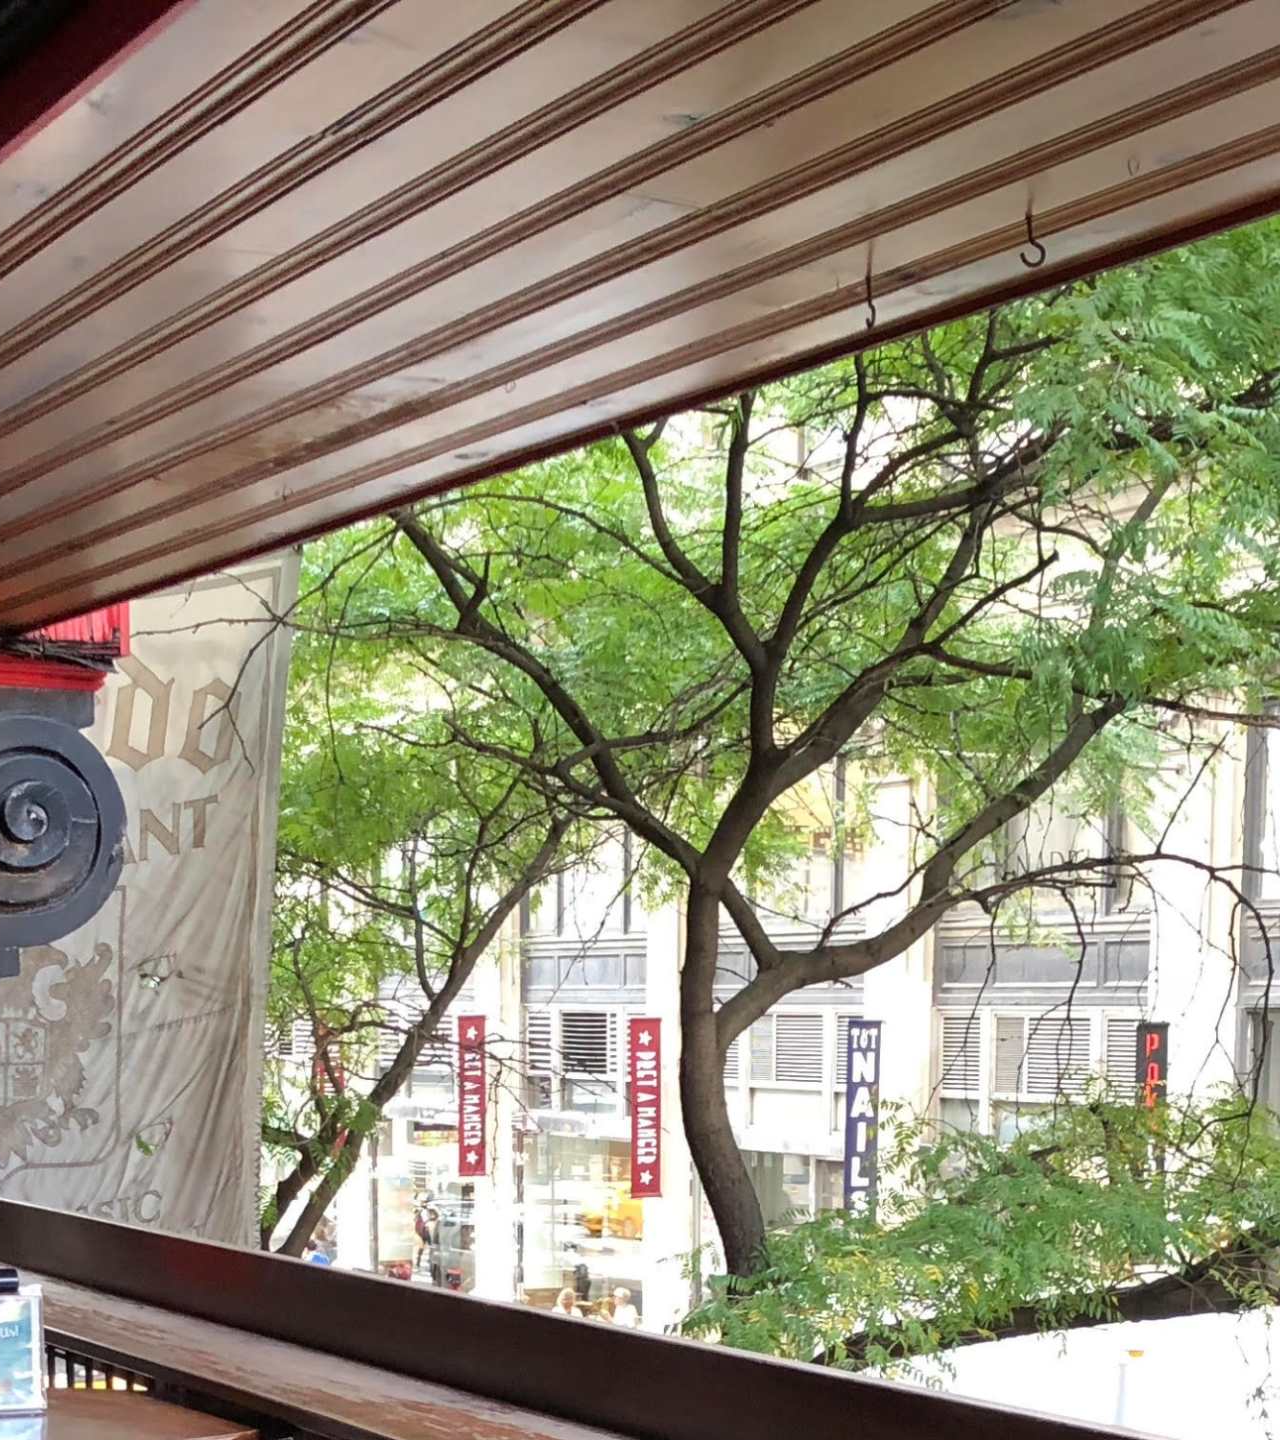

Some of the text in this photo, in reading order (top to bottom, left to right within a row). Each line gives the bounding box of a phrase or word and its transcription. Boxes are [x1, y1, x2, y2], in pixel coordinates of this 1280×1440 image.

[636, 1051, 658, 1165] PRET A MANGER
